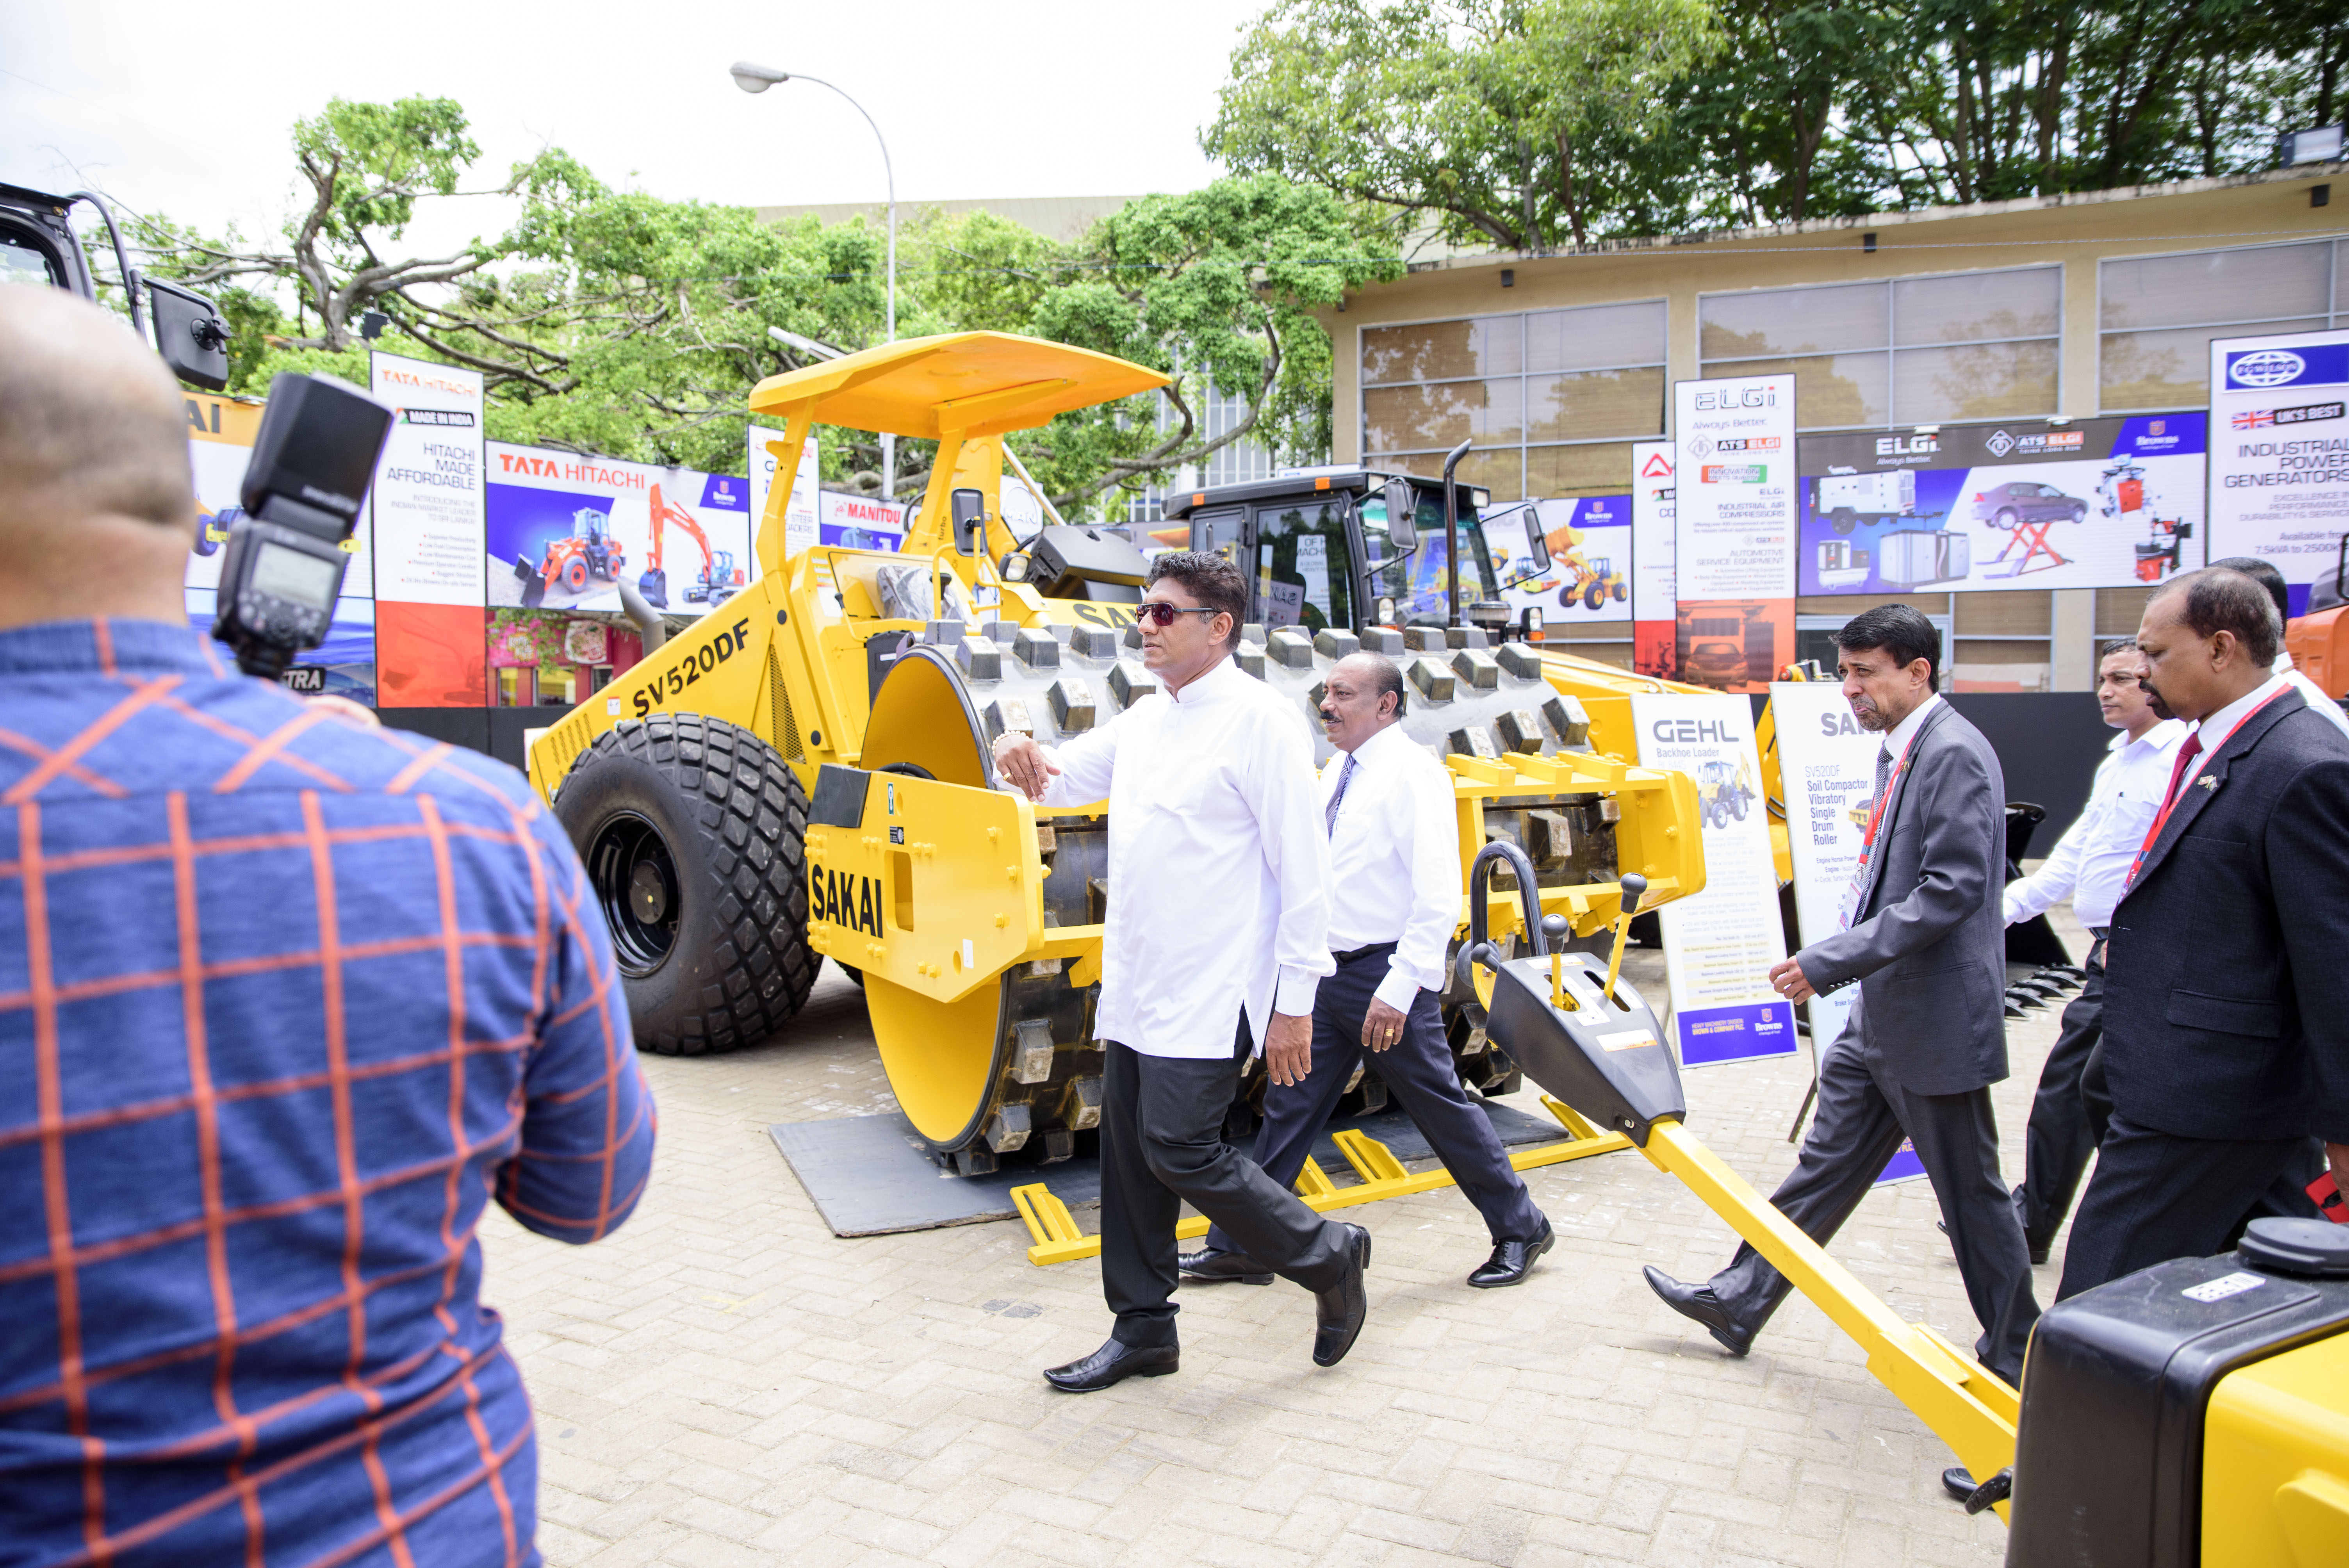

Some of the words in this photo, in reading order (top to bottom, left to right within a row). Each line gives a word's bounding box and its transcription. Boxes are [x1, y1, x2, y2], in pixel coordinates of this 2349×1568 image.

[383, 369, 420, 386] TATA
[424, 378, 476, 396] HITACHI
[1696, 386, 1775, 410] ELGi
[409, 410, 437, 424] MADE
[437, 412, 448, 424] IN
[448, 413, 474, 426] INDIA
[2277, 409, 2306, 423] UK'S
[2308, 404, 2342, 419] BEST
[1693, 420, 1729, 430] Always
[1719, 440, 1746, 450] ATS
[1749, 438, 1779, 448] ELGI
[2019, 436, 2046, 447] ATS
[2049, 434, 2080, 444] ELGI
[2136, 435, 2179, 446] Browns
[424, 442, 475, 461] HITACHI
[2239, 438, 2349, 458] INDUSTRIAL
[436, 459, 474, 476] MADE
[1876, 457, 1905, 466] Always
[499, 453, 559, 478] TATA
[566, 463, 645, 490] HITACHI
[2225, 469, 2349, 488] GENERATORS
[387, 468, 475, 490] AFFORDABLE
[848, 503, 900, 524] MANITOU
[1584, 512, 1613, 520] Browns
[2279, 531, 2326, 541] Available
[2328, 530, 2343, 539] fro
[2292, 545, 2302, 553] to
[1734, 557, 1784, 565] EQUIPMENT
[633, 617, 749, 718] SV520DF
[1653, 720, 1739, 742] GEHL
[1657, 748, 1691, 757] Backhoe
[1693, 747, 1719, 757] Loader
[1805, 764, 1840, 778] SV520DF
[1807, 780, 1822, 791] Soil
[1825, 778, 1868, 792] Compactor
[1809, 793, 1846, 806] Vibratory
[1811, 807, 1835, 820] Single
[1812, 821, 1834, 832] Drum
[1813, 834, 1837, 845] Roller
[812, 864, 883, 939] SAKAI
[1755, 1022, 1783, 1032] Browns
